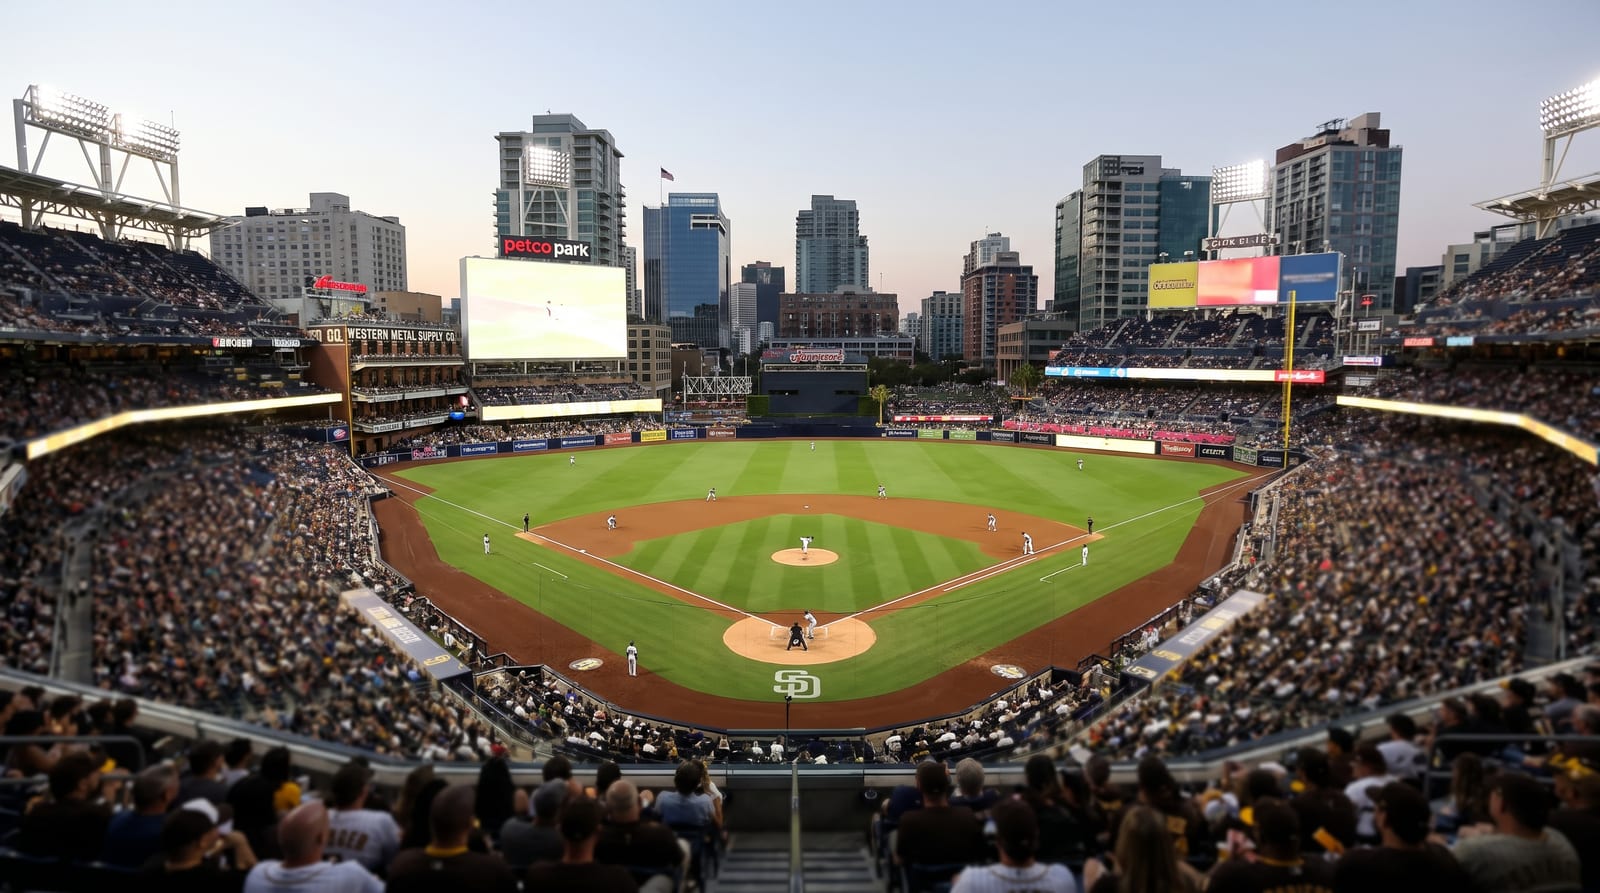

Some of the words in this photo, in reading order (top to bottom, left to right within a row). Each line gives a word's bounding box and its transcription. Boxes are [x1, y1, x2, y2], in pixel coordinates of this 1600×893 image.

[504, 239, 552, 254] petco
[554, 242, 589, 258] park
[348, 327, 388, 341] WESTERN
[391, 329, 417, 341] METAL
[418, 330, 443, 342] SUPPLY
[773, 669, 821, 699] SD
